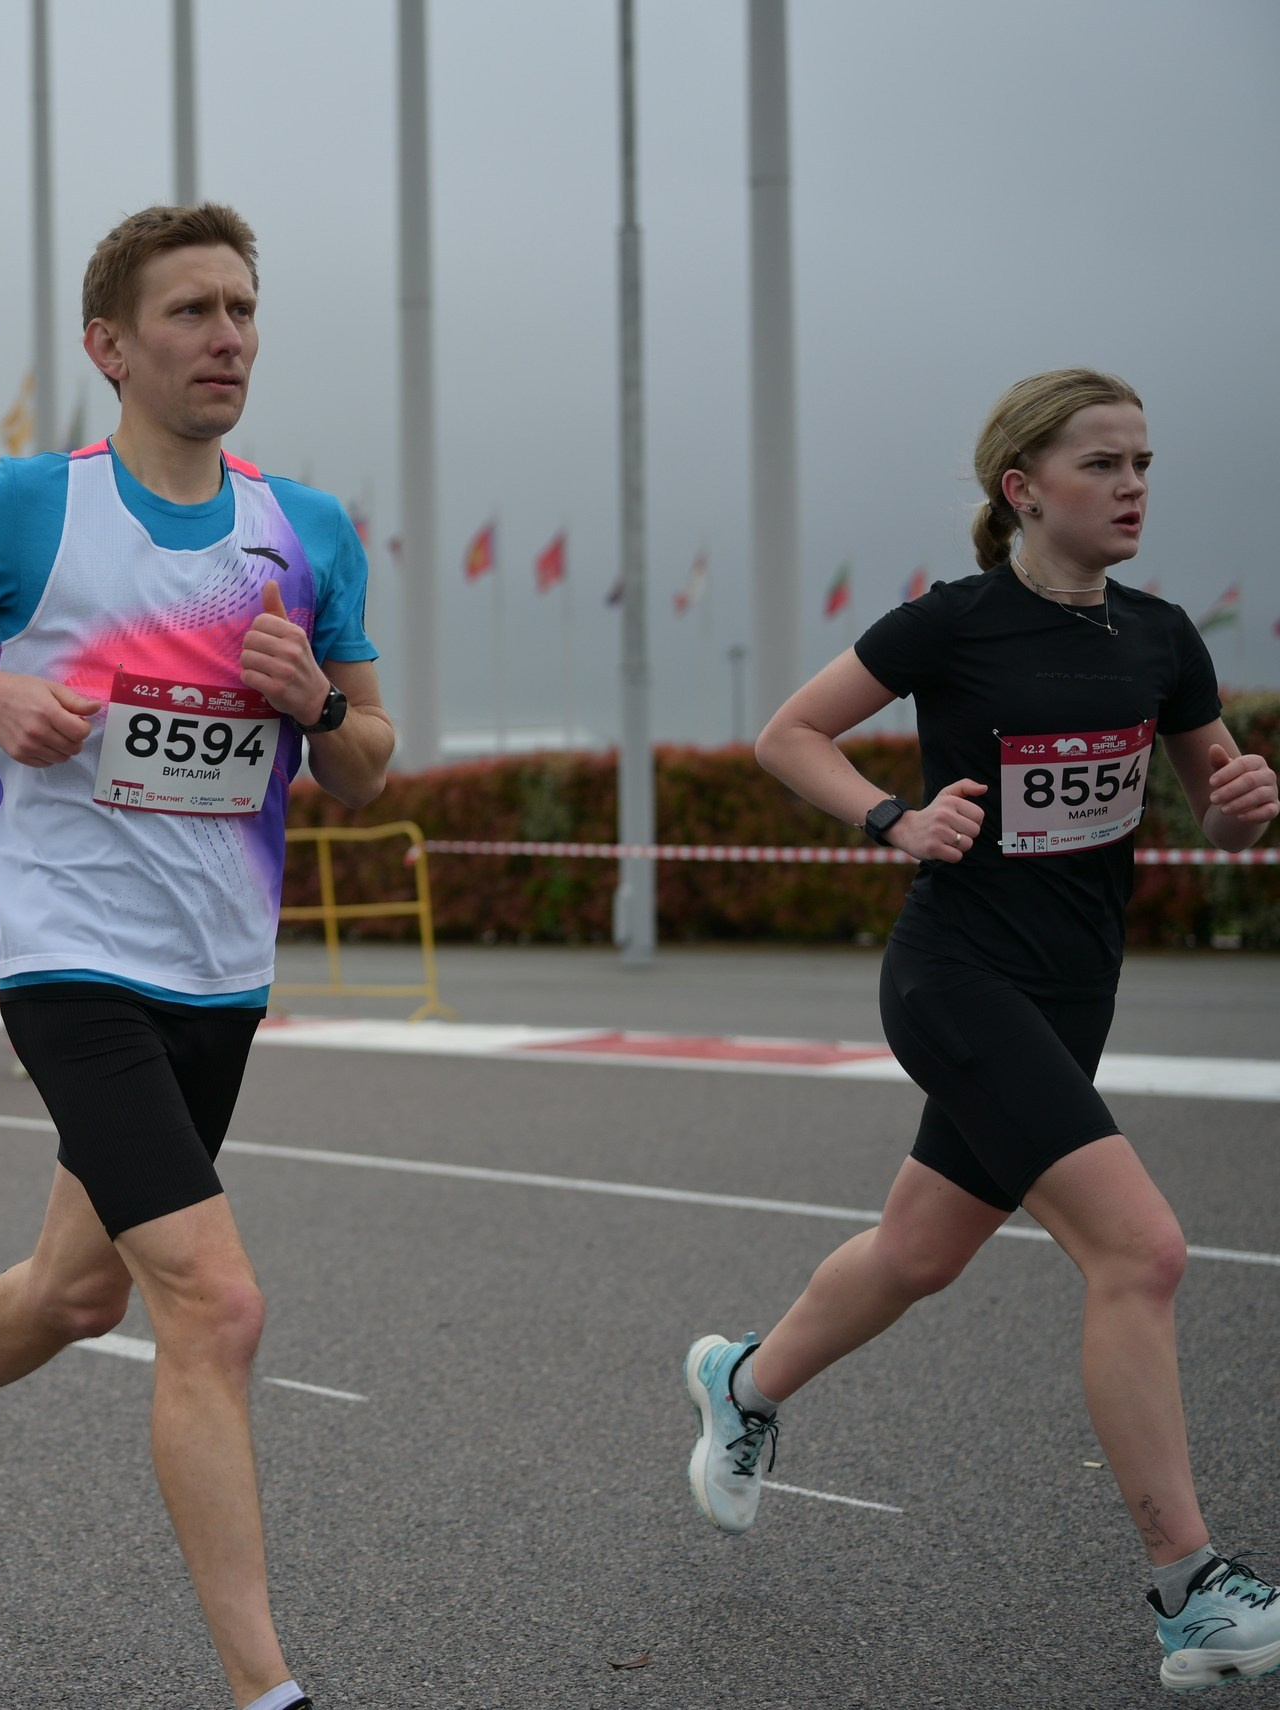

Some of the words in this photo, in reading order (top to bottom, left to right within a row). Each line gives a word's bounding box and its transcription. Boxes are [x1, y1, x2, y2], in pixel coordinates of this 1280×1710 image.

[1035, 671, 1071, 679] ANTA
[1073, 673, 1133, 682] RUNNING
[132, 684, 160, 698] 42.2
[208, 697, 245, 708] SIRIUS
[125, 712, 265, 766] 8594
[1092, 739, 1127, 750] SIRIUS
[1020, 744, 1046, 754] 42.2
[162, 766, 221, 780] ВИТАЛИЙ
[1023, 754, 1141, 809] 8554
[156, 795, 184, 803] МАГНИТ
[230, 797, 252, 806] RAY
[1068, 806, 1108, 820] МАРИЯ
[1060, 835, 1086, 843] МАГНИТ
